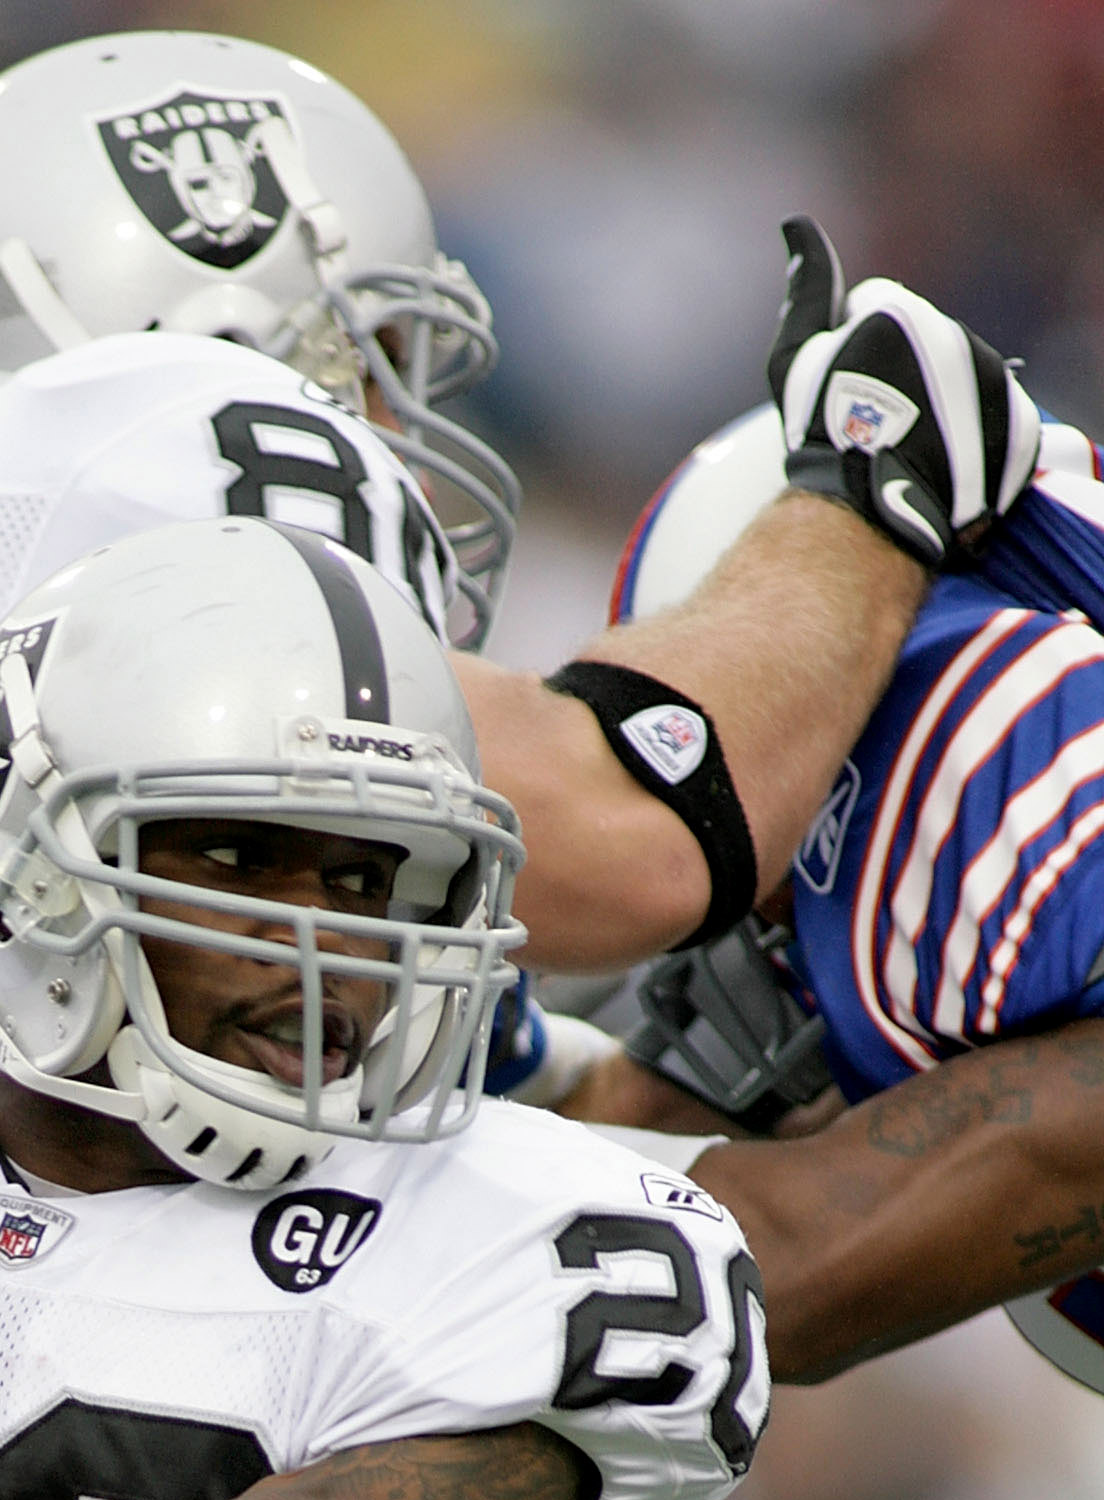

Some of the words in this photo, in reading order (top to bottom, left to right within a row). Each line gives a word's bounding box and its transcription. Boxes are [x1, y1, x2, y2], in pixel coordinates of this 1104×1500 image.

[112, 100, 272, 140] RAIDERS
[271, 1204, 375, 1267] GU
[295, 1267, 322, 1284] 63
